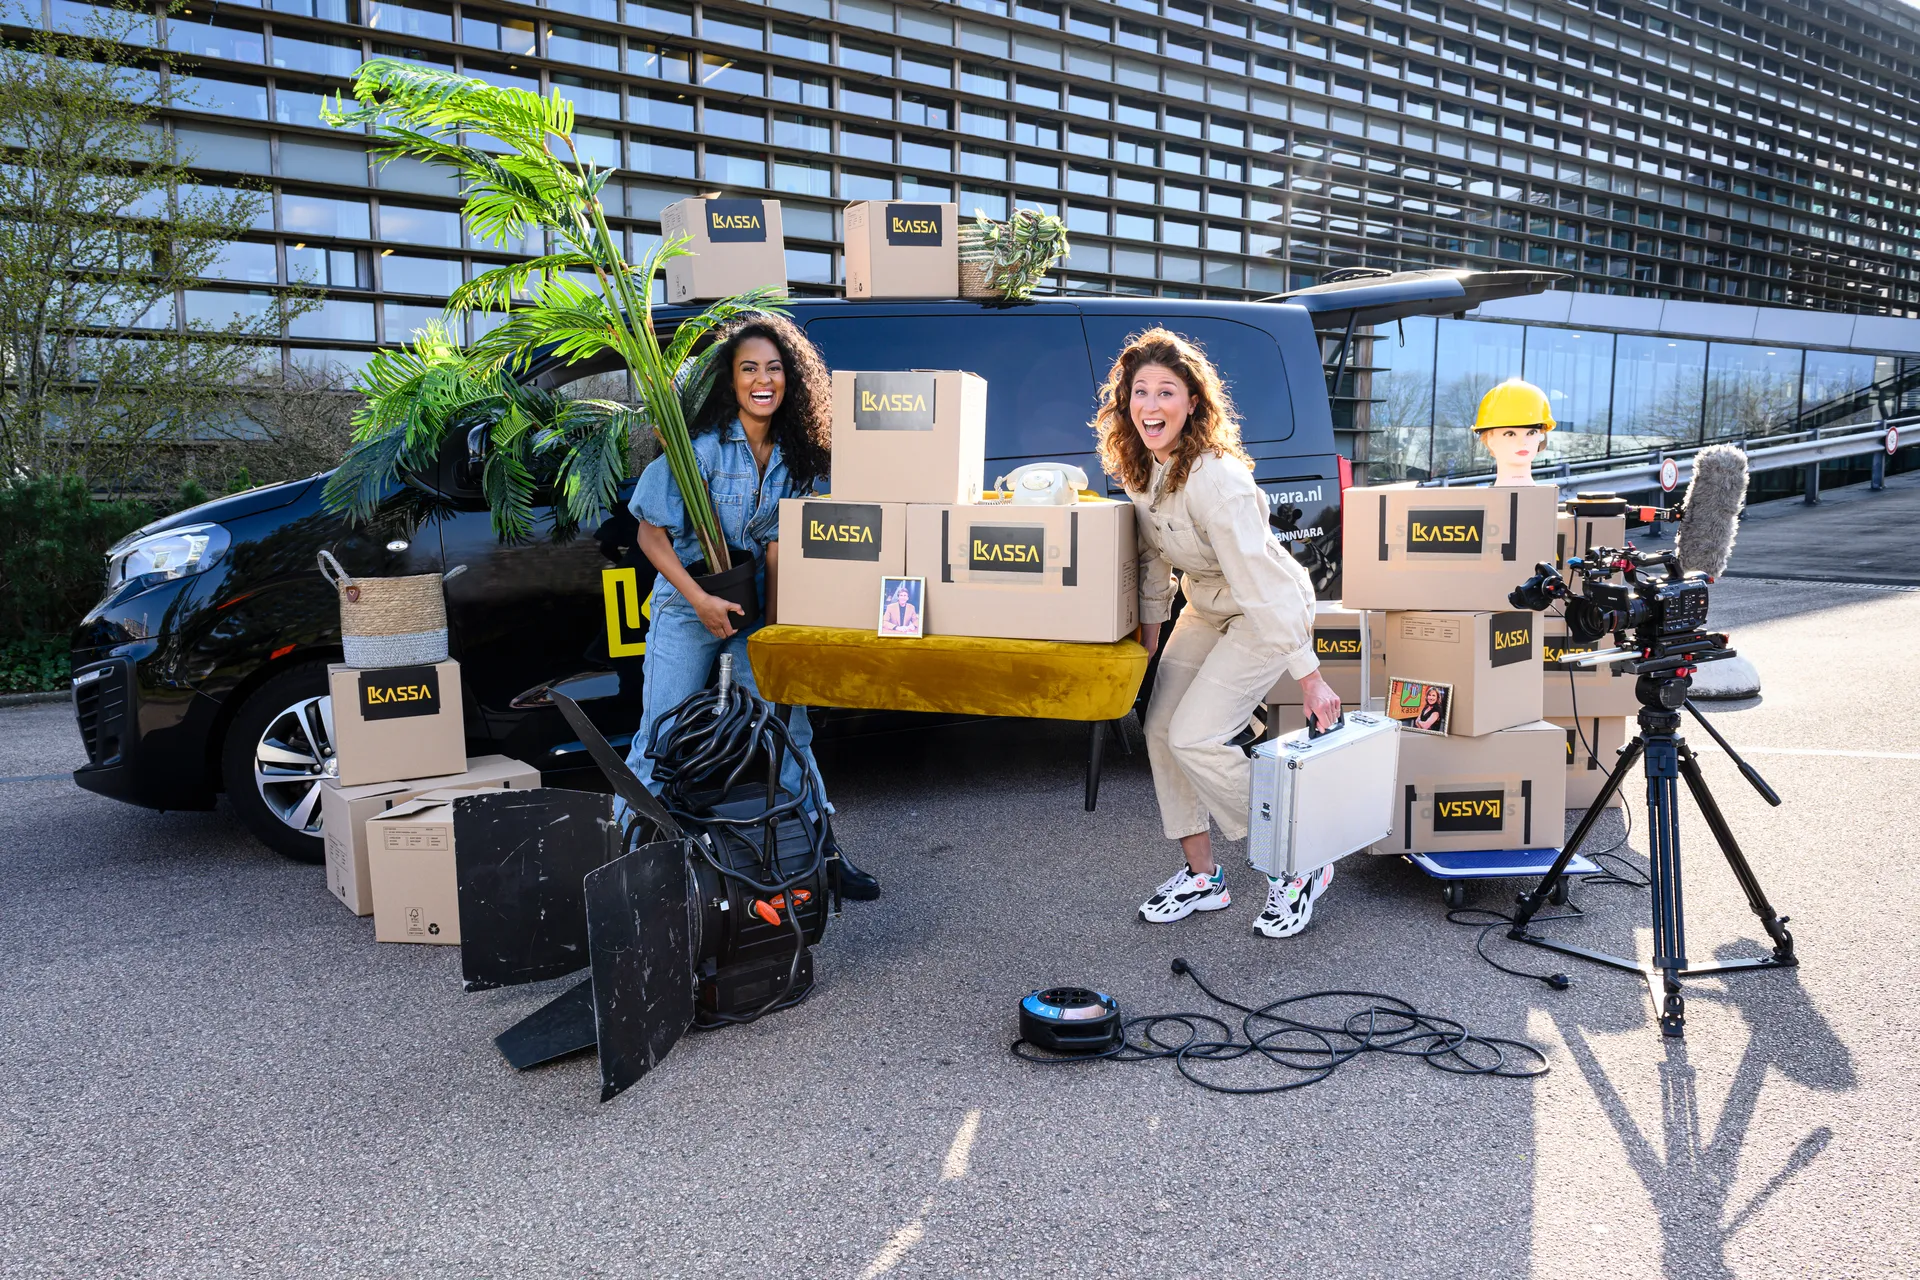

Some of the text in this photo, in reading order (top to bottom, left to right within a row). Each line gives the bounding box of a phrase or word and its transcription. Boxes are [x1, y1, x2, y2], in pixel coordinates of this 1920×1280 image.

[713, 213, 760, 229] KASSA
[893, 217, 938, 234] KASSA
[862, 390, 926, 411] KASSA
[810, 520, 873, 543] KASSA
[1412, 523, 1479, 542] KASSA
[973, 540, 1040, 563] KASSA
[1495, 629, 1530, 650] KASSA
[368, 684, 431, 704] KASSA
